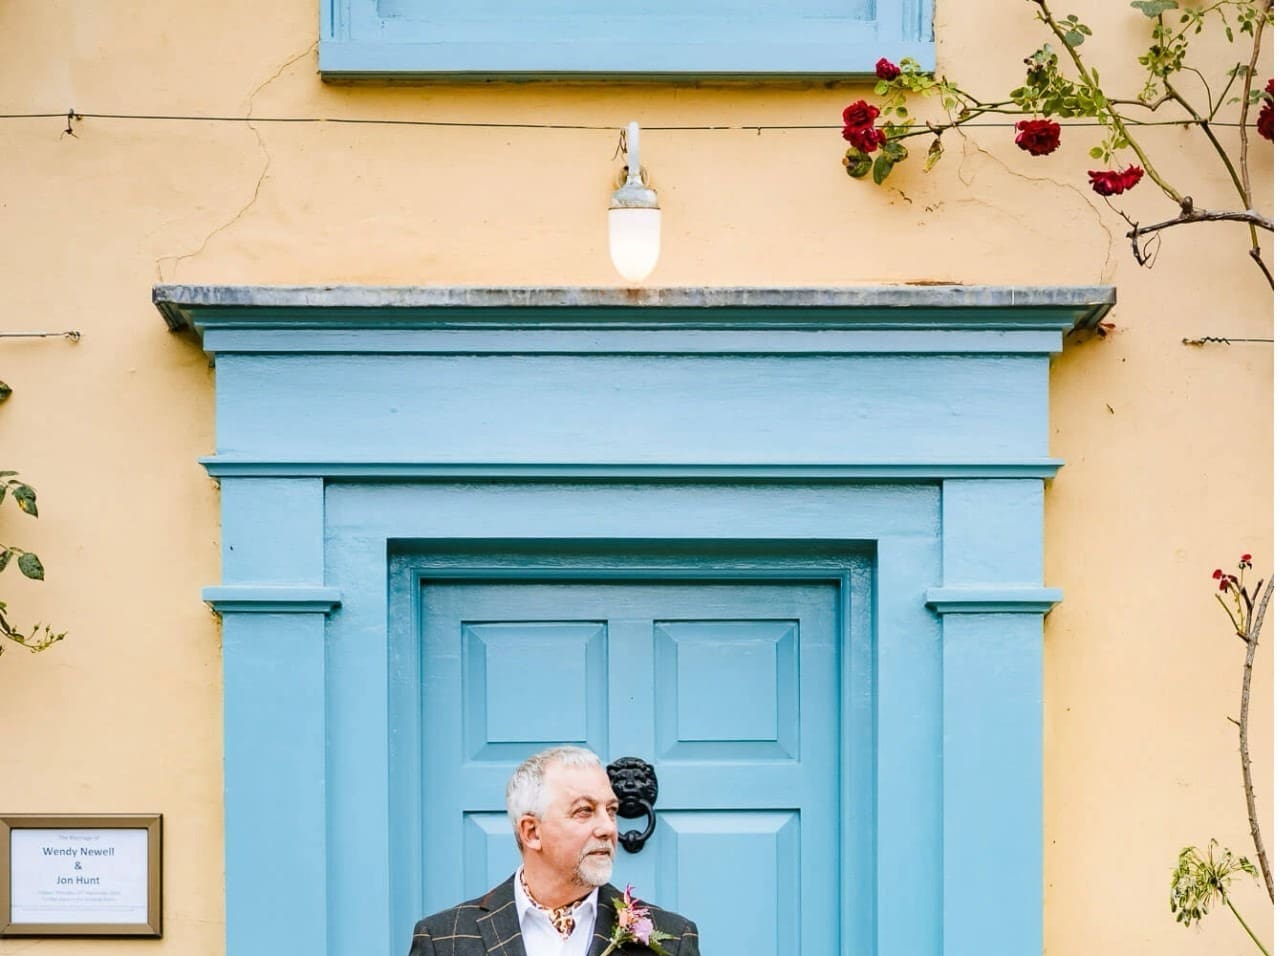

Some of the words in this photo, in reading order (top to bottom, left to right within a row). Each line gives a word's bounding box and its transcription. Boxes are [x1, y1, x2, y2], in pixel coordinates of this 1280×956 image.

[42, 847, 78, 858] Wendy
[80, 847, 115, 856] Newell
[74, 861, 83, 870] &
[56, 875, 73, 885] Jon
[76, 875, 100, 885] Hunt
